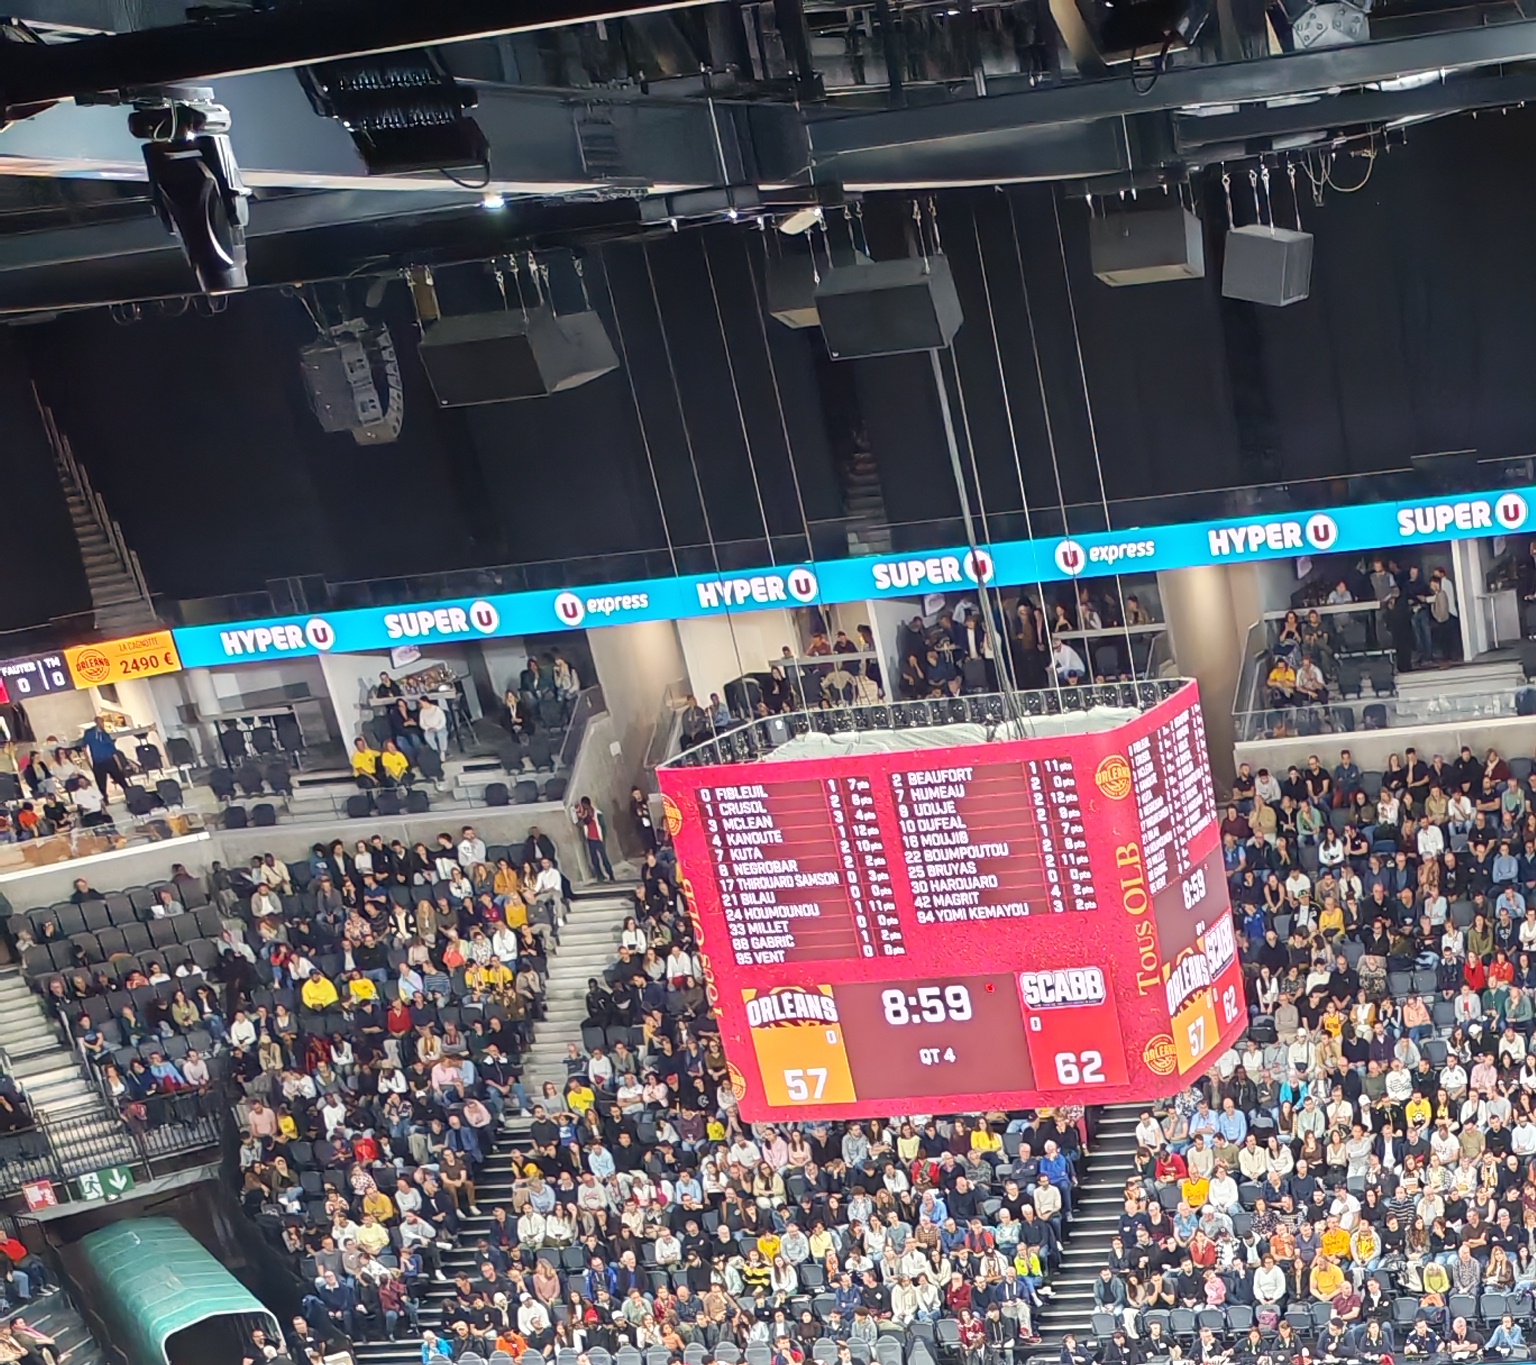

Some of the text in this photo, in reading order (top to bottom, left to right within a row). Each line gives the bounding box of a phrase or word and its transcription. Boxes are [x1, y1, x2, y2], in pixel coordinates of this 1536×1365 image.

[1397, 500, 1519, 535] SUPER U
[1207, 522, 1330, 557] HYPER U
[1062, 539, 1156, 569] U express
[872, 556, 988, 590] SUPER U
[697, 574, 811, 608] HYPER U
[562, 591, 649, 621] U express
[384, 606, 494, 640] SUPER U
[221, 624, 330, 657] HYPER U
[119, 652, 175, 674] 2490 €
[892, 767, 973, 787] 2 BEAUFORT
[715, 785, 768, 801] FIBLEUIL
[894, 784, 965, 802] 7 HUMEAU
[706, 801, 768, 816] 1 CRUSOL
[708, 815, 773, 832] 3 MCLEAN
[899, 816, 967, 833] 10 DUFEAL
[711, 829, 783, 847] 4 KANOUTE
[715, 847, 763, 862] 7 KUTA
[905, 852, 922, 864] 22
[733, 860, 798, 877] NEGROBAR
[907, 861, 977, 879] 25 BRUYAS
[1115, 842, 1147, 915] OLB
[720, 879, 734, 892] 17
[796, 871, 840, 887] SAMSON
[911, 882, 928, 894] 30
[1182, 868, 1206, 910] 8:59
[722, 894, 739, 907] 21
[914, 891, 980, 909] 42 MAGRIT
[725, 909, 742, 922] 24
[729, 920, 789, 936] 33 MILLET
[750, 934, 795, 950] GABRIC
[754, 950, 786, 964] VENT
[1022, 968, 1105, 1006] SCABB
[747, 993, 839, 1027] ORLÉANS
[882, 985, 972, 1025] 8:59
[1223, 985, 1239, 1024] 62
[1187, 1016, 1206, 1057] 57
[920, 1047, 956, 1065] QT 4
[1054, 1051, 1106, 1085] 62
[784, 1068, 828, 1101] 57
